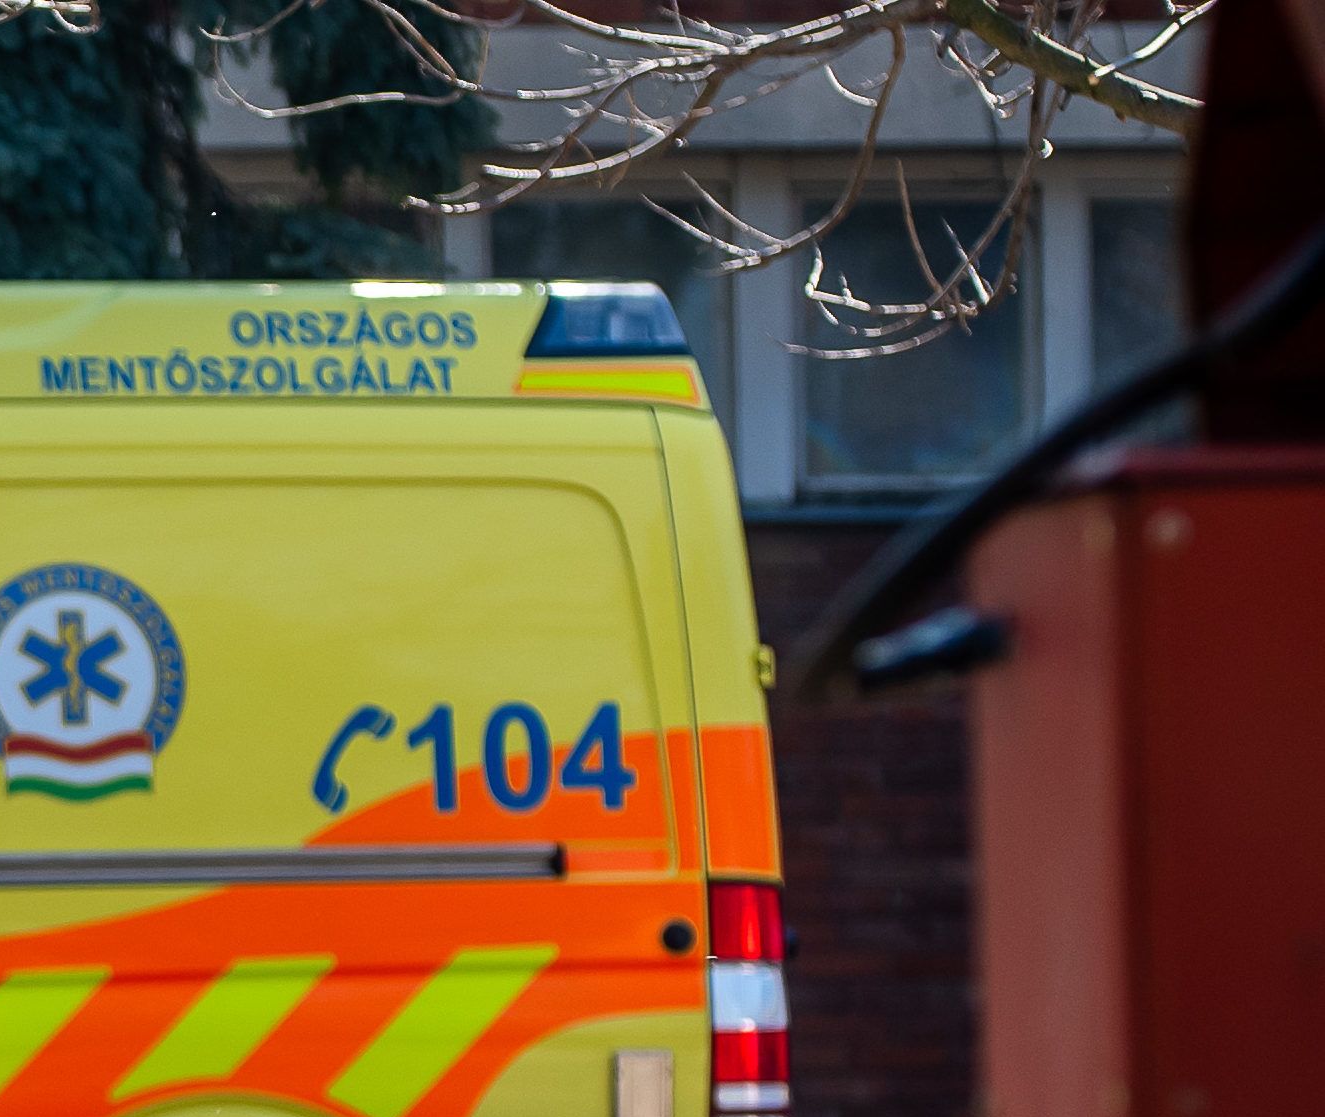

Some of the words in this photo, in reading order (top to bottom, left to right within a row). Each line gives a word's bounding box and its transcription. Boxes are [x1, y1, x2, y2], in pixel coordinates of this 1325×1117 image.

[230, 304, 478, 349] ORSZÁGOS
[40, 350, 459, 395] MENTŐSZOLGÁLAT
[407, 700, 638, 814] 104
